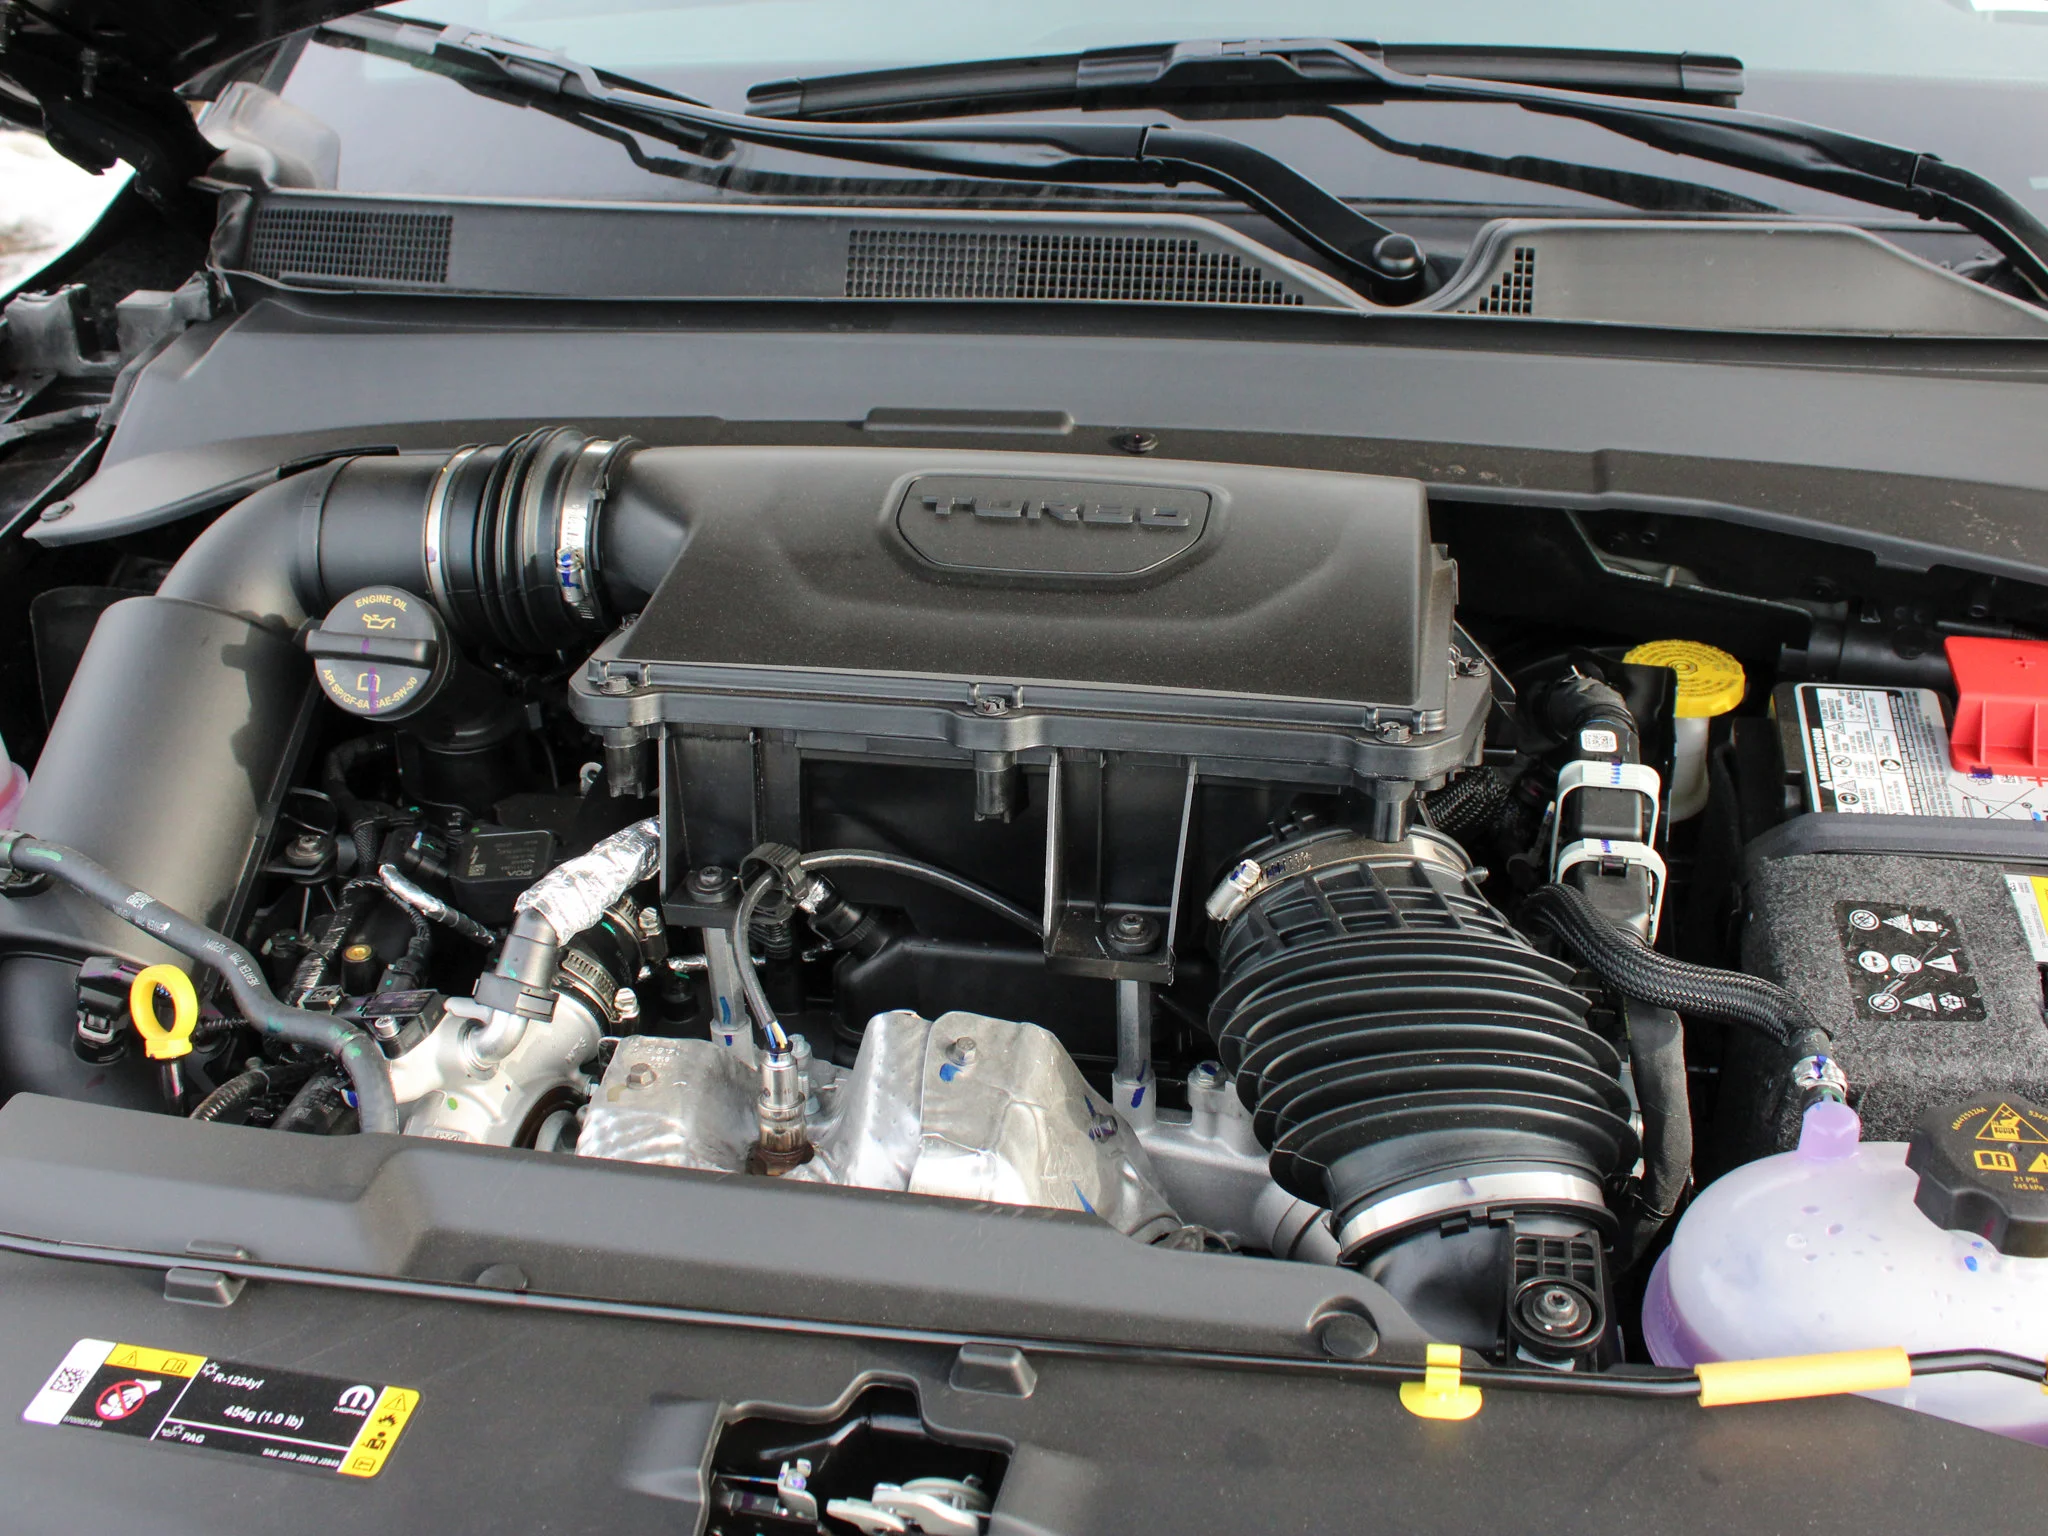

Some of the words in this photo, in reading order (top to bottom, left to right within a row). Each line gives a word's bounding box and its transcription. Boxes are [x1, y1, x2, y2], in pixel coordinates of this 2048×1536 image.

[355, 594, 393, 608] ENGINE
[393, 598, 408, 612] OIL
[323, 669, 336, 686] API
[212, 1371, 265, 1390] R-1234yf
[223, 1404, 255, 1424] 454g
[257, 1409, 283, 1427] (1.0
[285, 1413, 305, 1430] lb)
[182, 1430, 205, 1444] PAG
